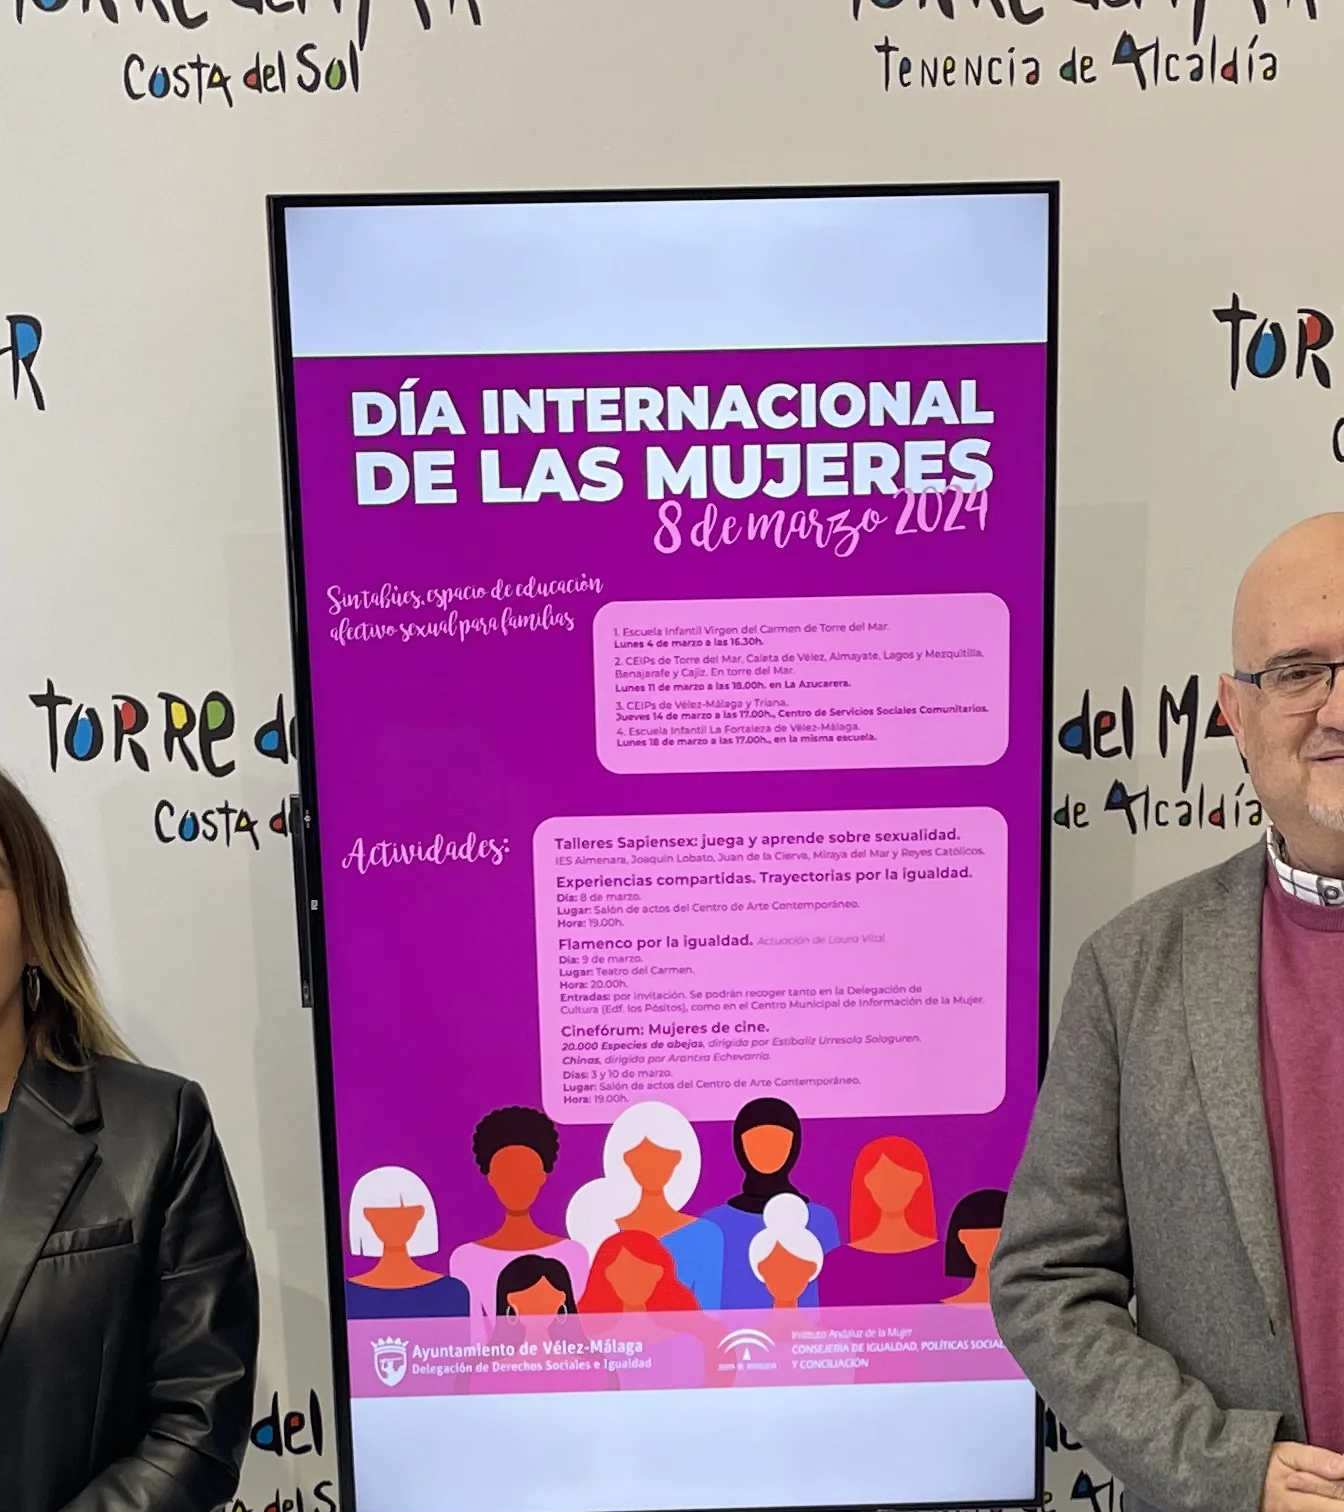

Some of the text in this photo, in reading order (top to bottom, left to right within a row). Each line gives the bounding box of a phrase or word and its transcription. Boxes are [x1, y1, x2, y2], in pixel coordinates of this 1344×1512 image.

[243, 51, 285, 93] del
[297, 40, 358, 92] Sol
[1060, 47, 1096, 84] de
[352, 379, 994, 437] DÍA INTERNACIONAL
[356, 439, 993, 506] DE LAS MUJERES
[654, 483, 988, 557] 8 de marzo 2024
[330, 604, 575, 647] afectivo sexual para familias
[1058, 686, 1133, 760] del
[1048, 789, 1089, 835] de
[341, 831, 510, 875] Actividades:
[554, 827, 960, 850] Talleres Sapiensex: juega y aprende sobre sexualidad.
[556, 866, 972, 890] Experiencias compartidas. Trayectorias por la igualdad.
[558, 933, 753, 951] Flamenco por la igualdad.
[560, 1020, 769, 1037] Cinefórum: Mujeres de cine.
[411, 1338, 642, 1361] Ayuntamiento de Vélez-Málaga
[411, 1354, 651, 1376] Delegación de Derechos Sociales e Igualdad
